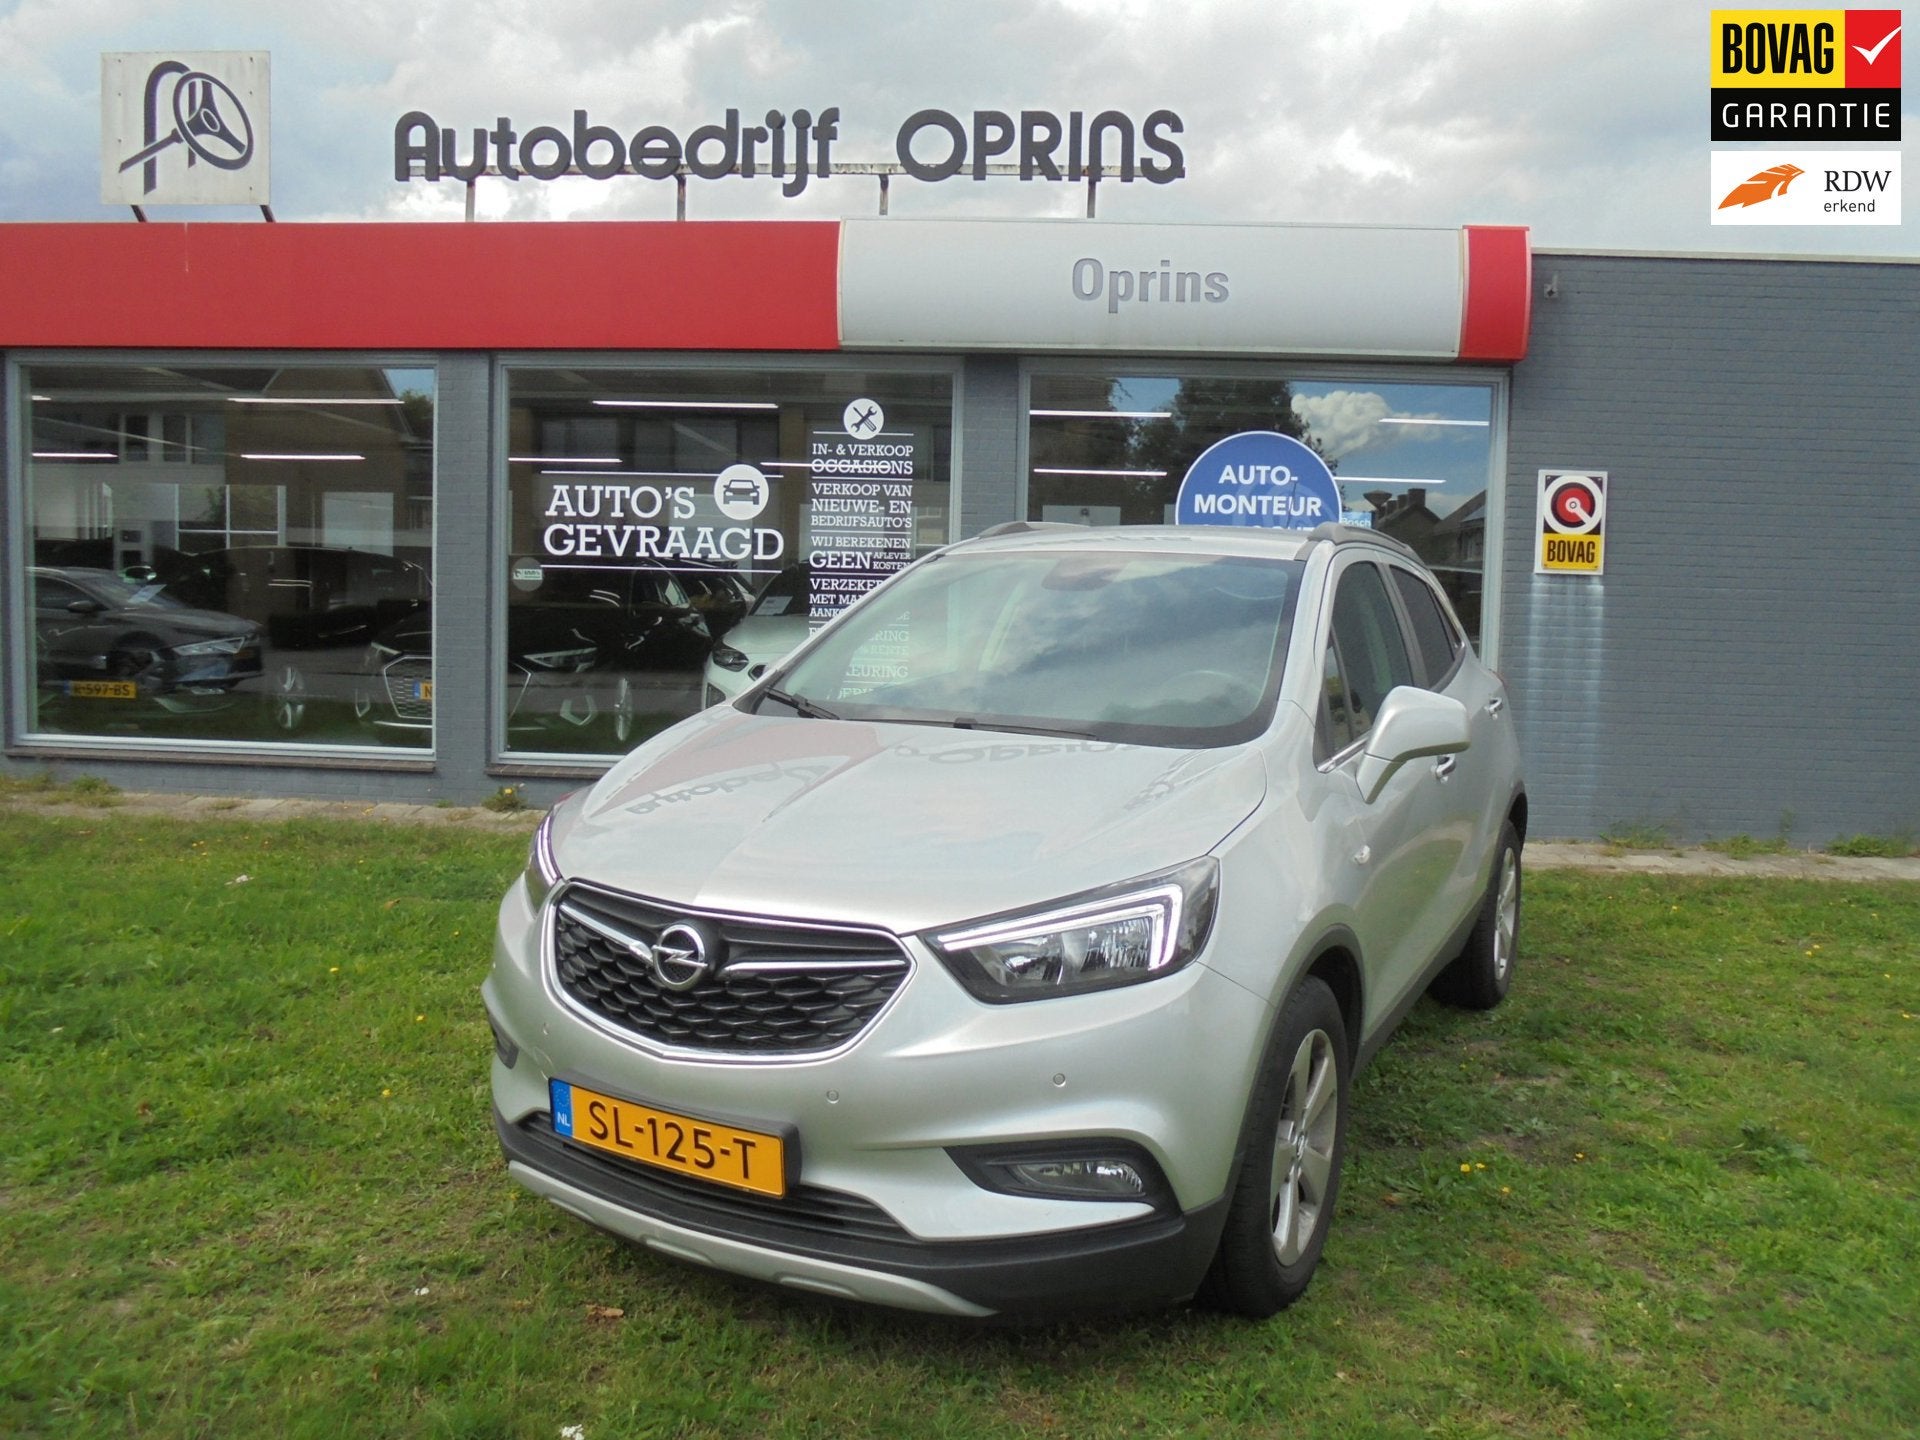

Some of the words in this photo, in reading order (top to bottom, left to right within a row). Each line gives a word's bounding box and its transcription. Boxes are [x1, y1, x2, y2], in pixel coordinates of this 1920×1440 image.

[394, 107, 840, 198] Autobedrijf
[896, 109, 1185, 185] OPRINS
[1072, 257, 1230, 314] Oprins
[812, 443, 832, 455] IN-
[836, 444, 846, 455] &
[848, 444, 914, 457] VERKOOP
[811, 458, 913, 475] OCCASIONS
[1218, 465, 1298, 486] AUTO-
[812, 482, 881, 496] VERKOOP
[883, 484, 913, 497] VAN
[545, 485, 696, 519] AUTO'S
[812, 498, 885, 513] NIEUWE-
[889, 500, 913, 514] EN
[1194, 494, 1322, 517] MONTEUR
[543, 524, 785, 560] GEVRAAGD
[811, 536, 833, 547] WIJ
[835, 537, 912, 549] BEREKENEN
[1547, 540, 1596, 563] BOVAG
[809, 551, 872, 570] GEEN
[873, 552, 911, 560] AFLEVER
[809, 594, 836, 604] MET
[557, 1112, 570, 1127] NL
[588, 1100, 756, 1179] SL-125-T
